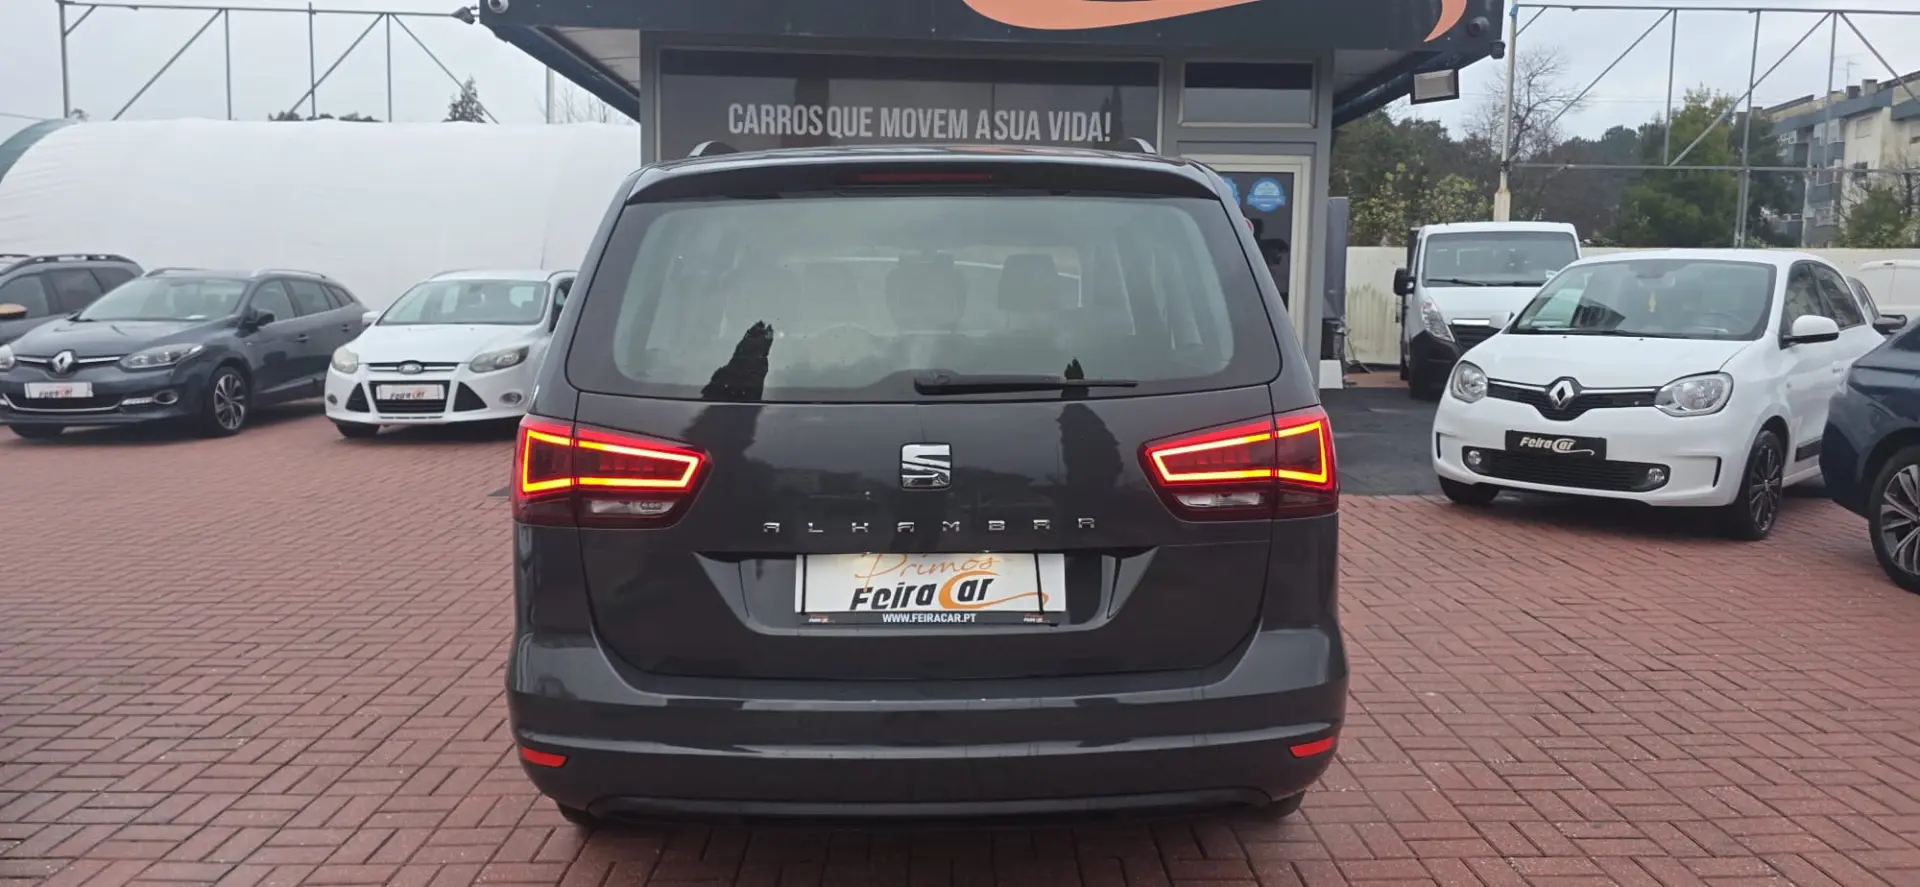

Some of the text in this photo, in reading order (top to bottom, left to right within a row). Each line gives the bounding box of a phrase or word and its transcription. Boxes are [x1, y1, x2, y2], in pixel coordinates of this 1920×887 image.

[728, 103, 1112, 142] CARROS QUE MOVEM A SUA VIDA!
[763, 517, 1095, 533] ALHAMBRA
[882, 612, 977, 624] WWW.FEIRACAR.PT
